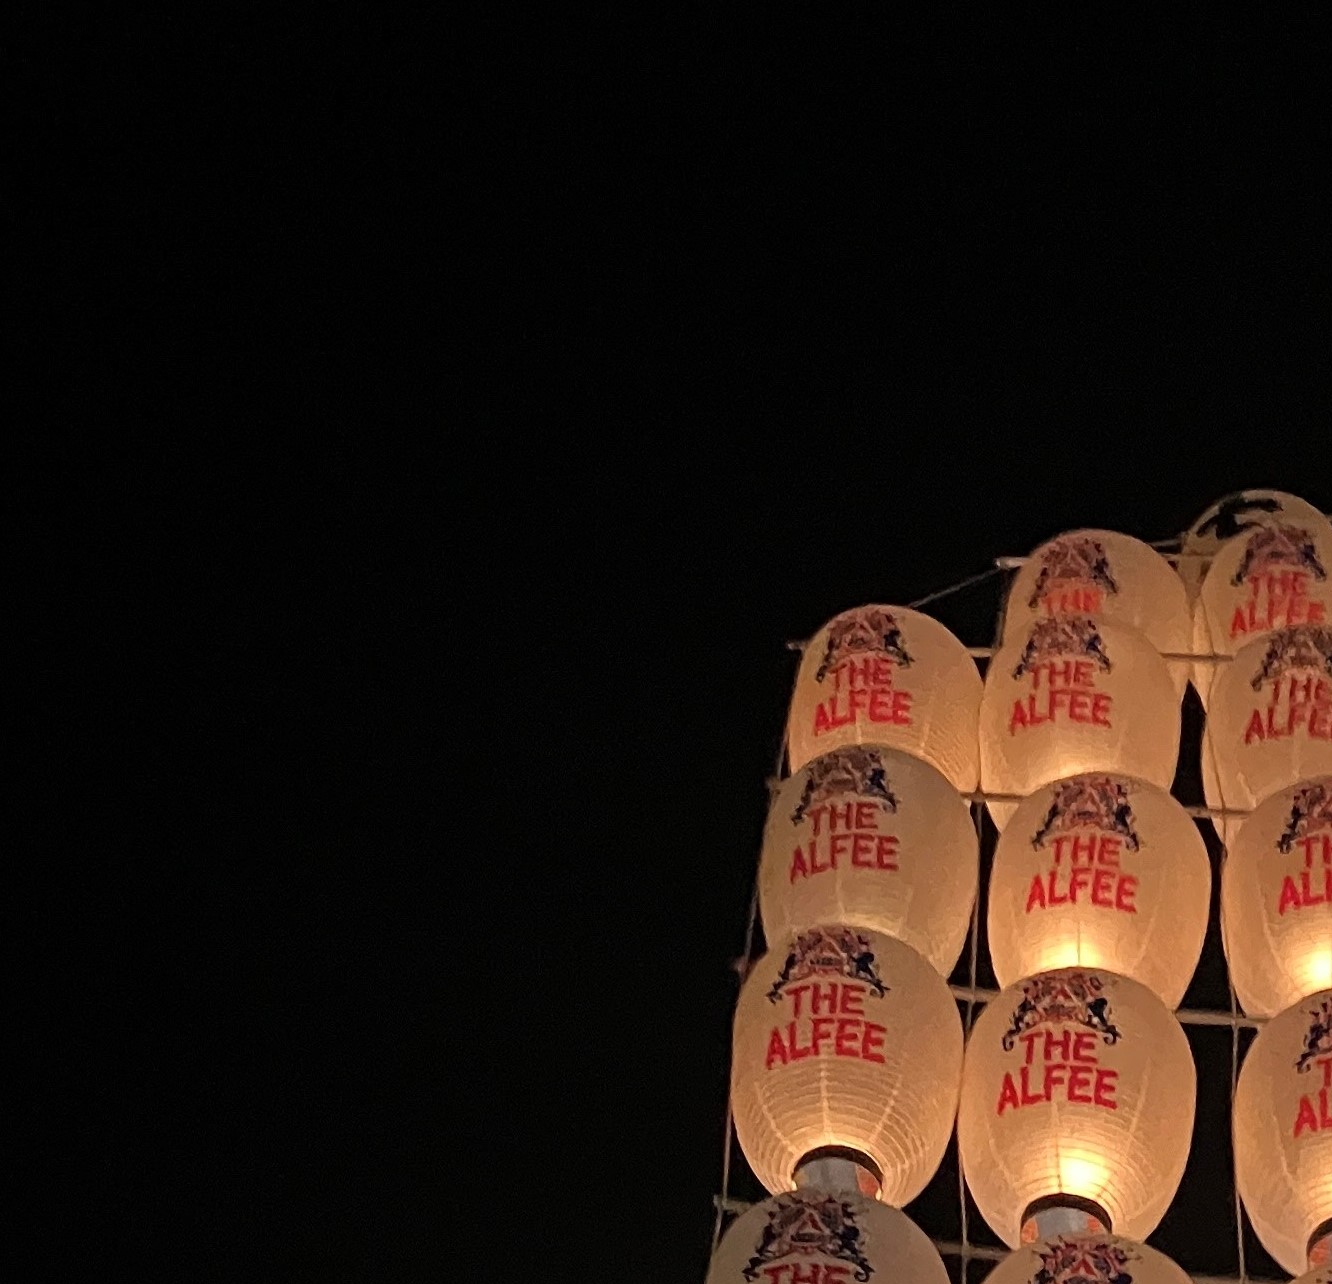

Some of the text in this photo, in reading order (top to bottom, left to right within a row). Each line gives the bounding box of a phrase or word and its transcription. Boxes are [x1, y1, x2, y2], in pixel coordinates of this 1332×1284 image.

[832, 657, 892, 690] THE
[1029, 658, 1096, 691] THE
[813, 690, 912, 736] ALFEE
[1010, 689, 1113, 736] ALFEE
[810, 802, 878, 836] THE
[790, 835, 900, 883] ALFEE
[1048, 836, 1121, 870] THE
[1025, 869, 1139, 915] ALFEE
[786, 984, 867, 1017] THE
[765, 1018, 888, 1071] ALFEE
[1019, 1031, 1098, 1065] THE
[996, 1064, 1119, 1116] ALFEE
